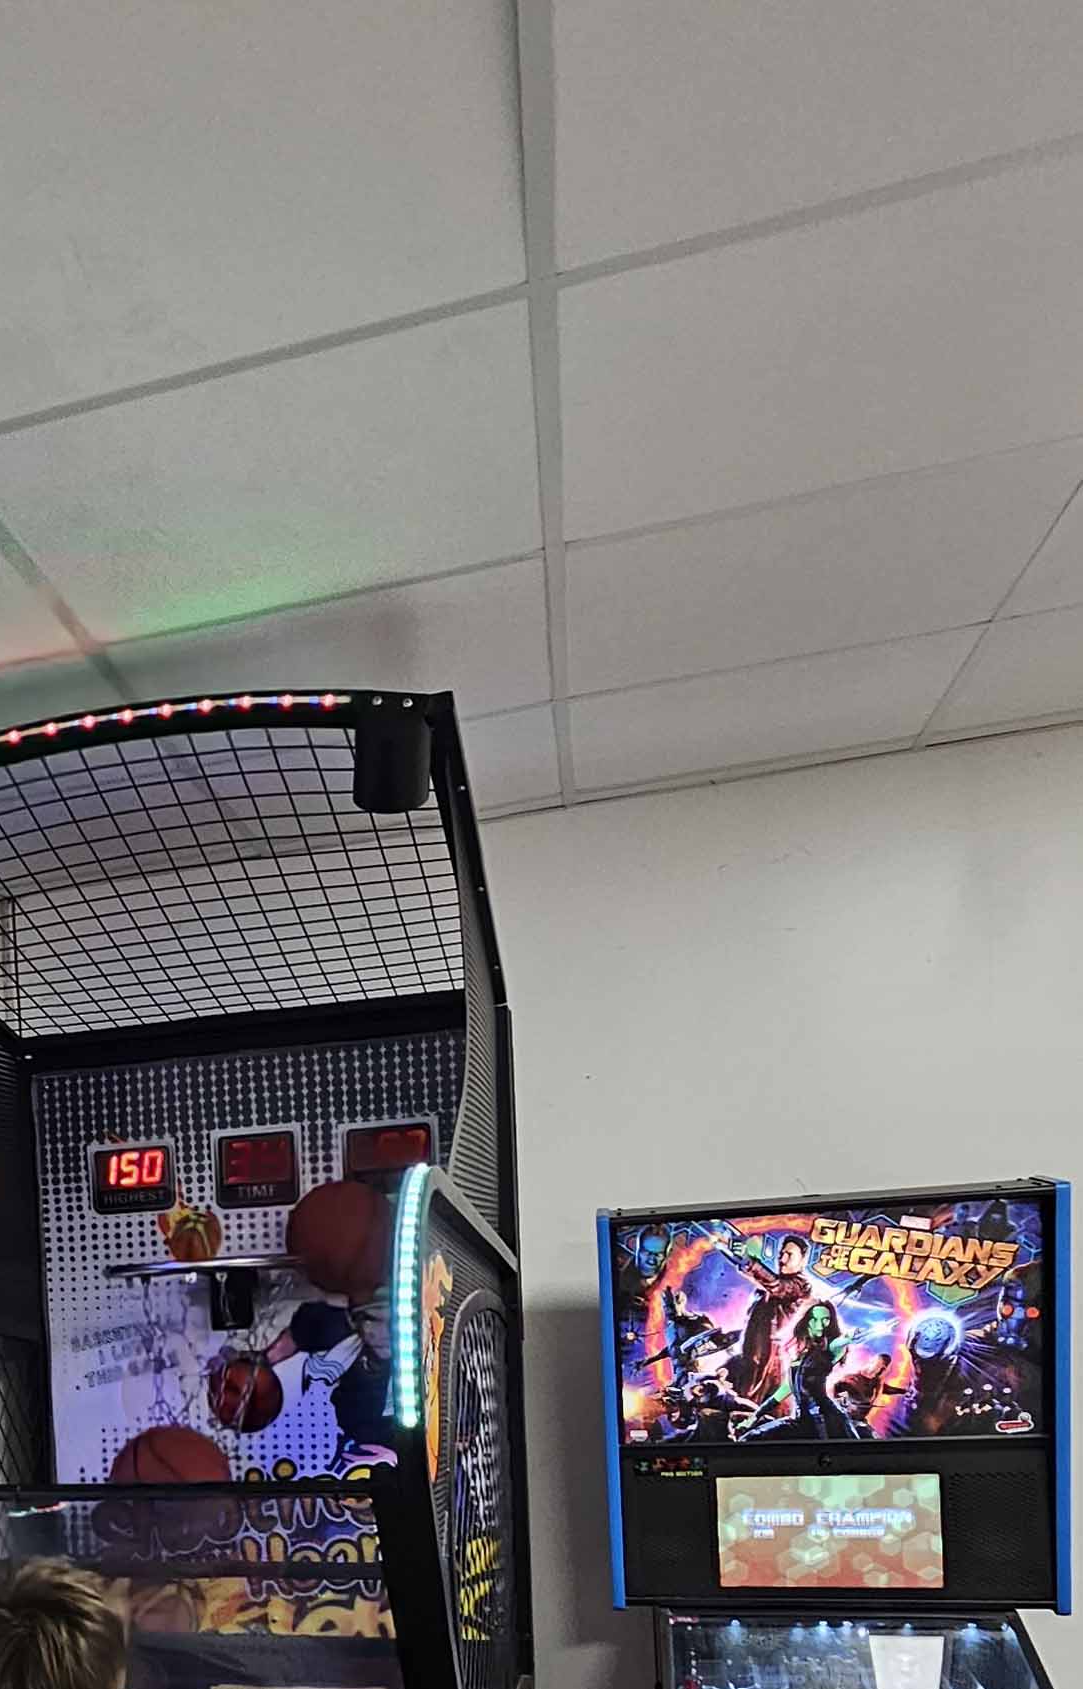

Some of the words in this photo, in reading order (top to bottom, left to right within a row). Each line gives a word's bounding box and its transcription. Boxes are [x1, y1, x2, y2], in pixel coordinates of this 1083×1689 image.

[108, 1150, 165, 1187] 150
[101, 1190, 166, 1207] HIGHEST
[236, 1184, 277, 1199] TIME
[811, 1218, 1020, 1268] GUARDIANS
[830, 1245, 852, 1259] OF
[820, 1253, 848, 1270] THE
[847, 1247, 1005, 1289] GALAXY
[741, 1507, 805, 1527] COMBO
[815, 1506, 914, 1529] CHAMPION
